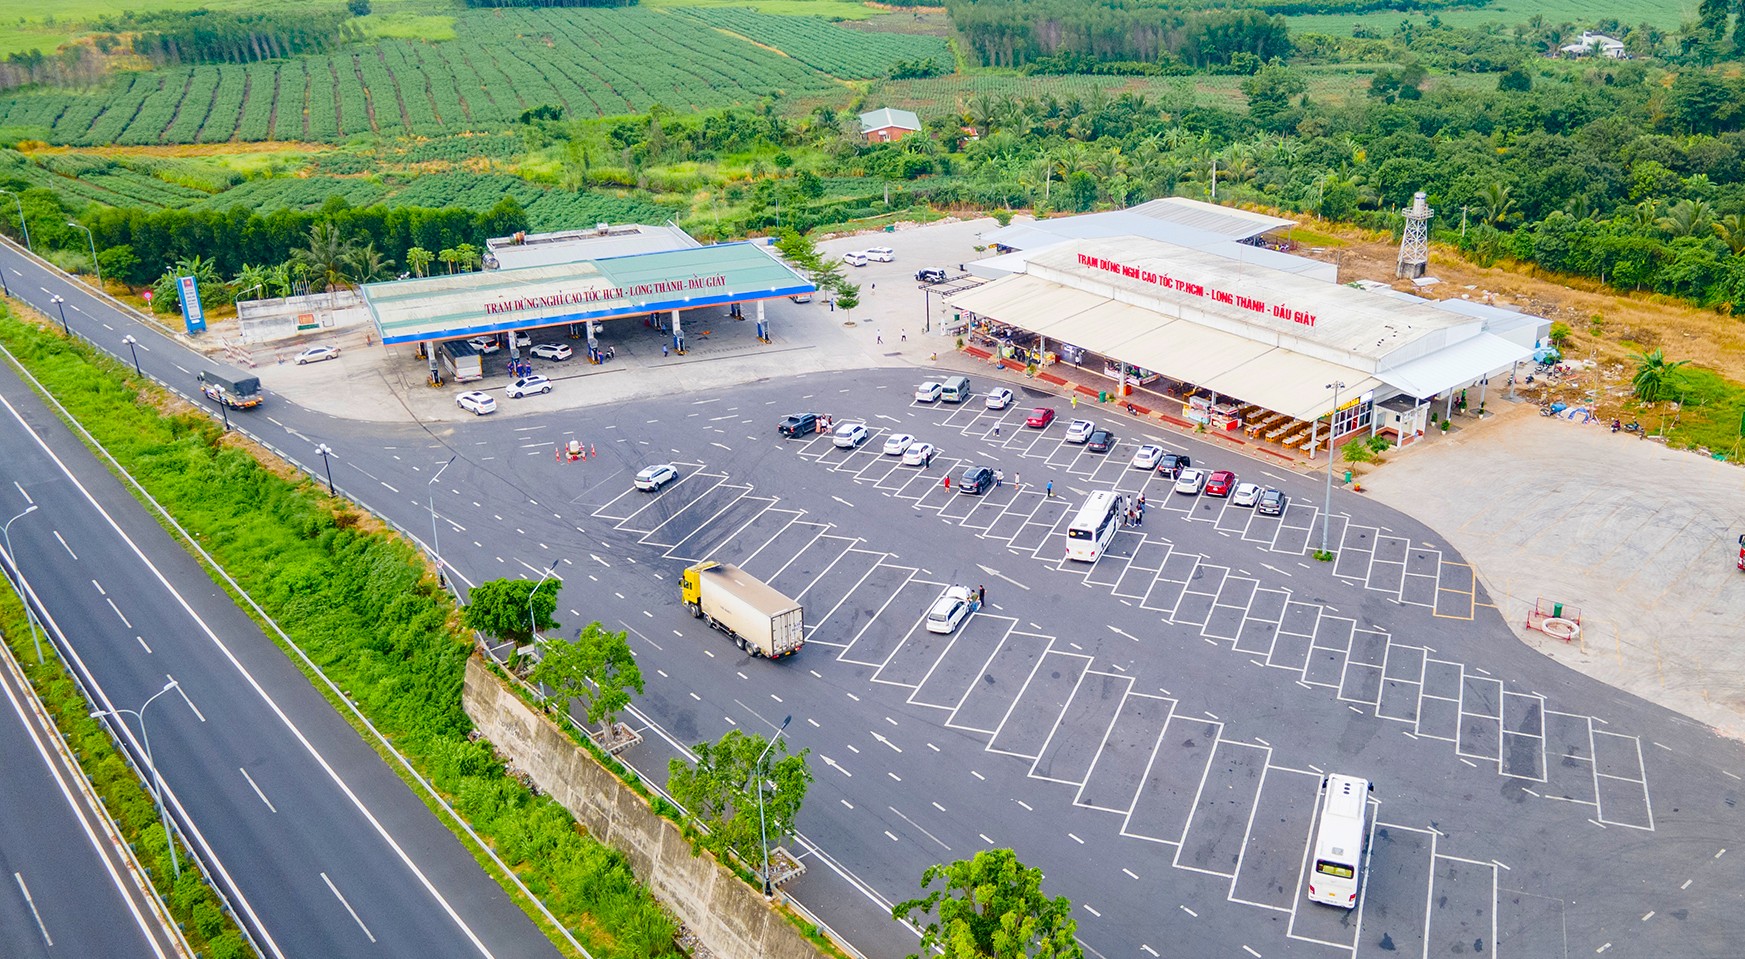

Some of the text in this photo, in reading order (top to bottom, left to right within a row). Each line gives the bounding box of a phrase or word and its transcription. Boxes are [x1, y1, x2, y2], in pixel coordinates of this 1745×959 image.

[565, 293, 582, 304] CAO
[584, 285, 601, 302] TỐC
[604, 288, 622, 300] HCM
[630, 284, 652, 296] LONG
[654, 279, 682, 293] THÀNH
[1077, 253, 1098, 268] TRẠM
[1100, 258, 1120, 274] DỪNG
[1122, 265, 1140, 279] NGHỈ
[1142, 271, 1156, 284] CAO
[1159, 273, 1173, 288] TỐC
[1175, 280, 1204, 296] TP.HCM
[1212, 289, 1233, 304] LONG
[1236, 295, 1264, 313] THÀNH
